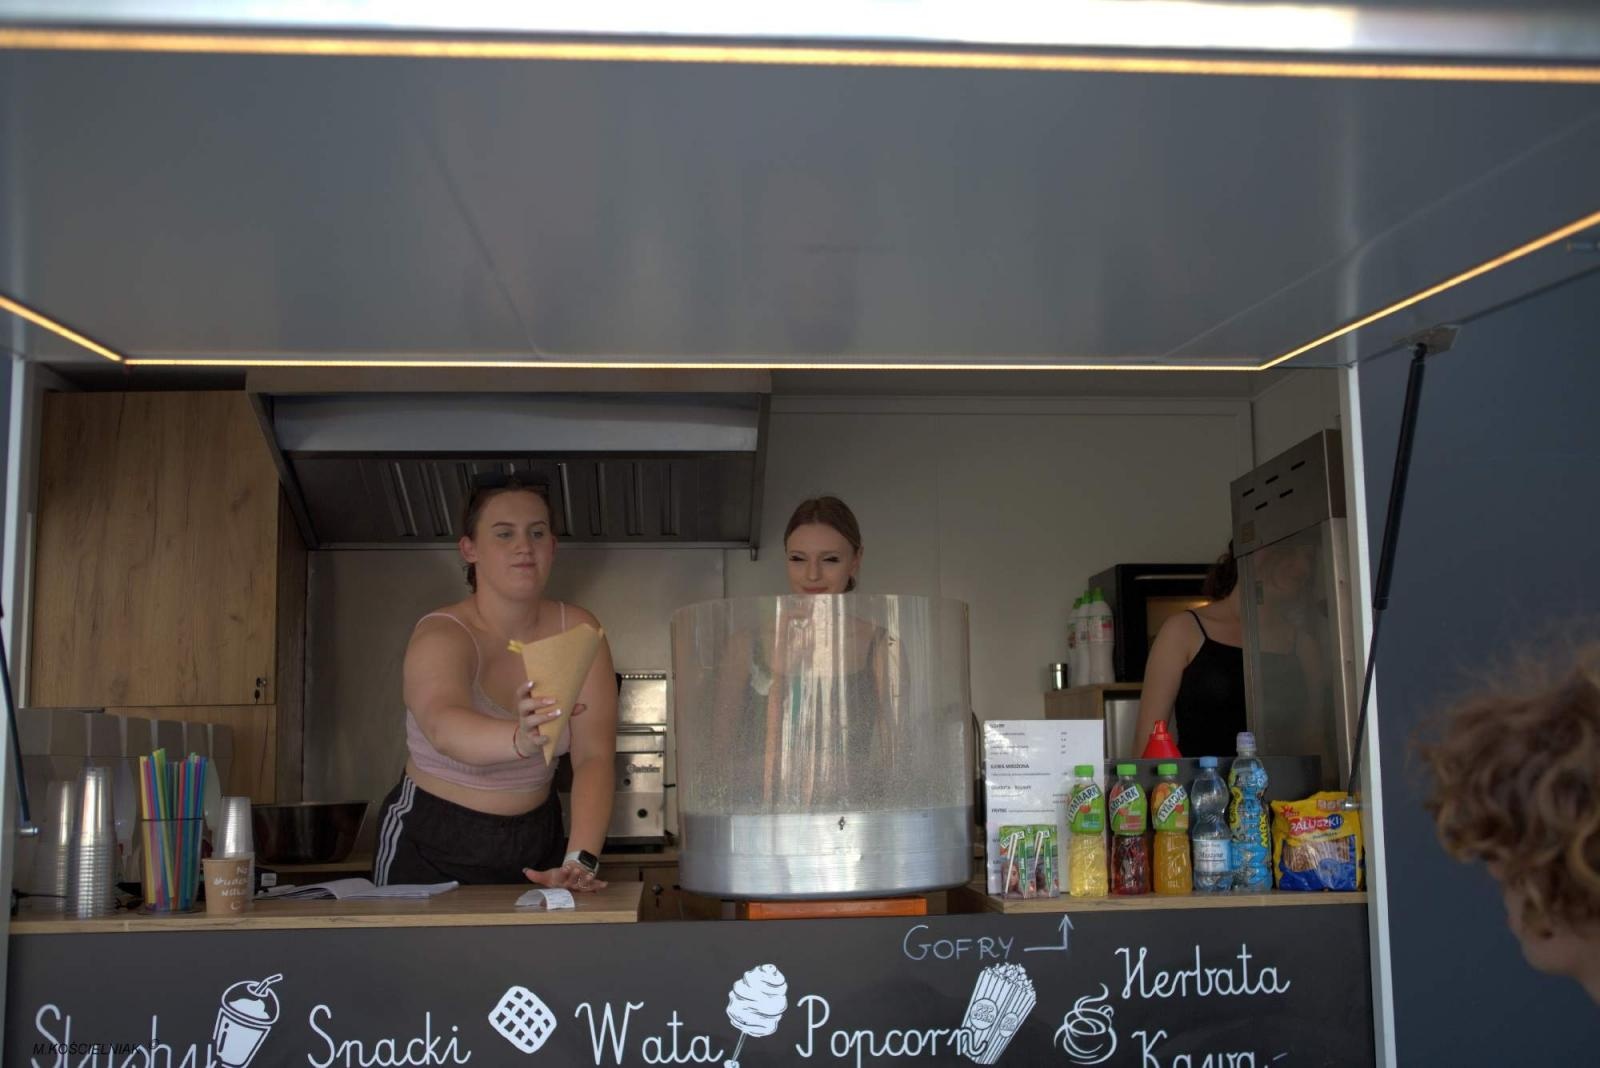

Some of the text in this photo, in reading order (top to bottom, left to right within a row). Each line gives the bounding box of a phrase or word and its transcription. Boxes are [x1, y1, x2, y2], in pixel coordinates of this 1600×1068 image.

[904, 924, 1014, 961] GOFRY
[1114, 943, 1291, 999] Herbata
[307, 1004, 472, 1068] Snacki
[574, 1001, 724, 1066] Wata
[795, 994, 988, 1068] Popcorn
